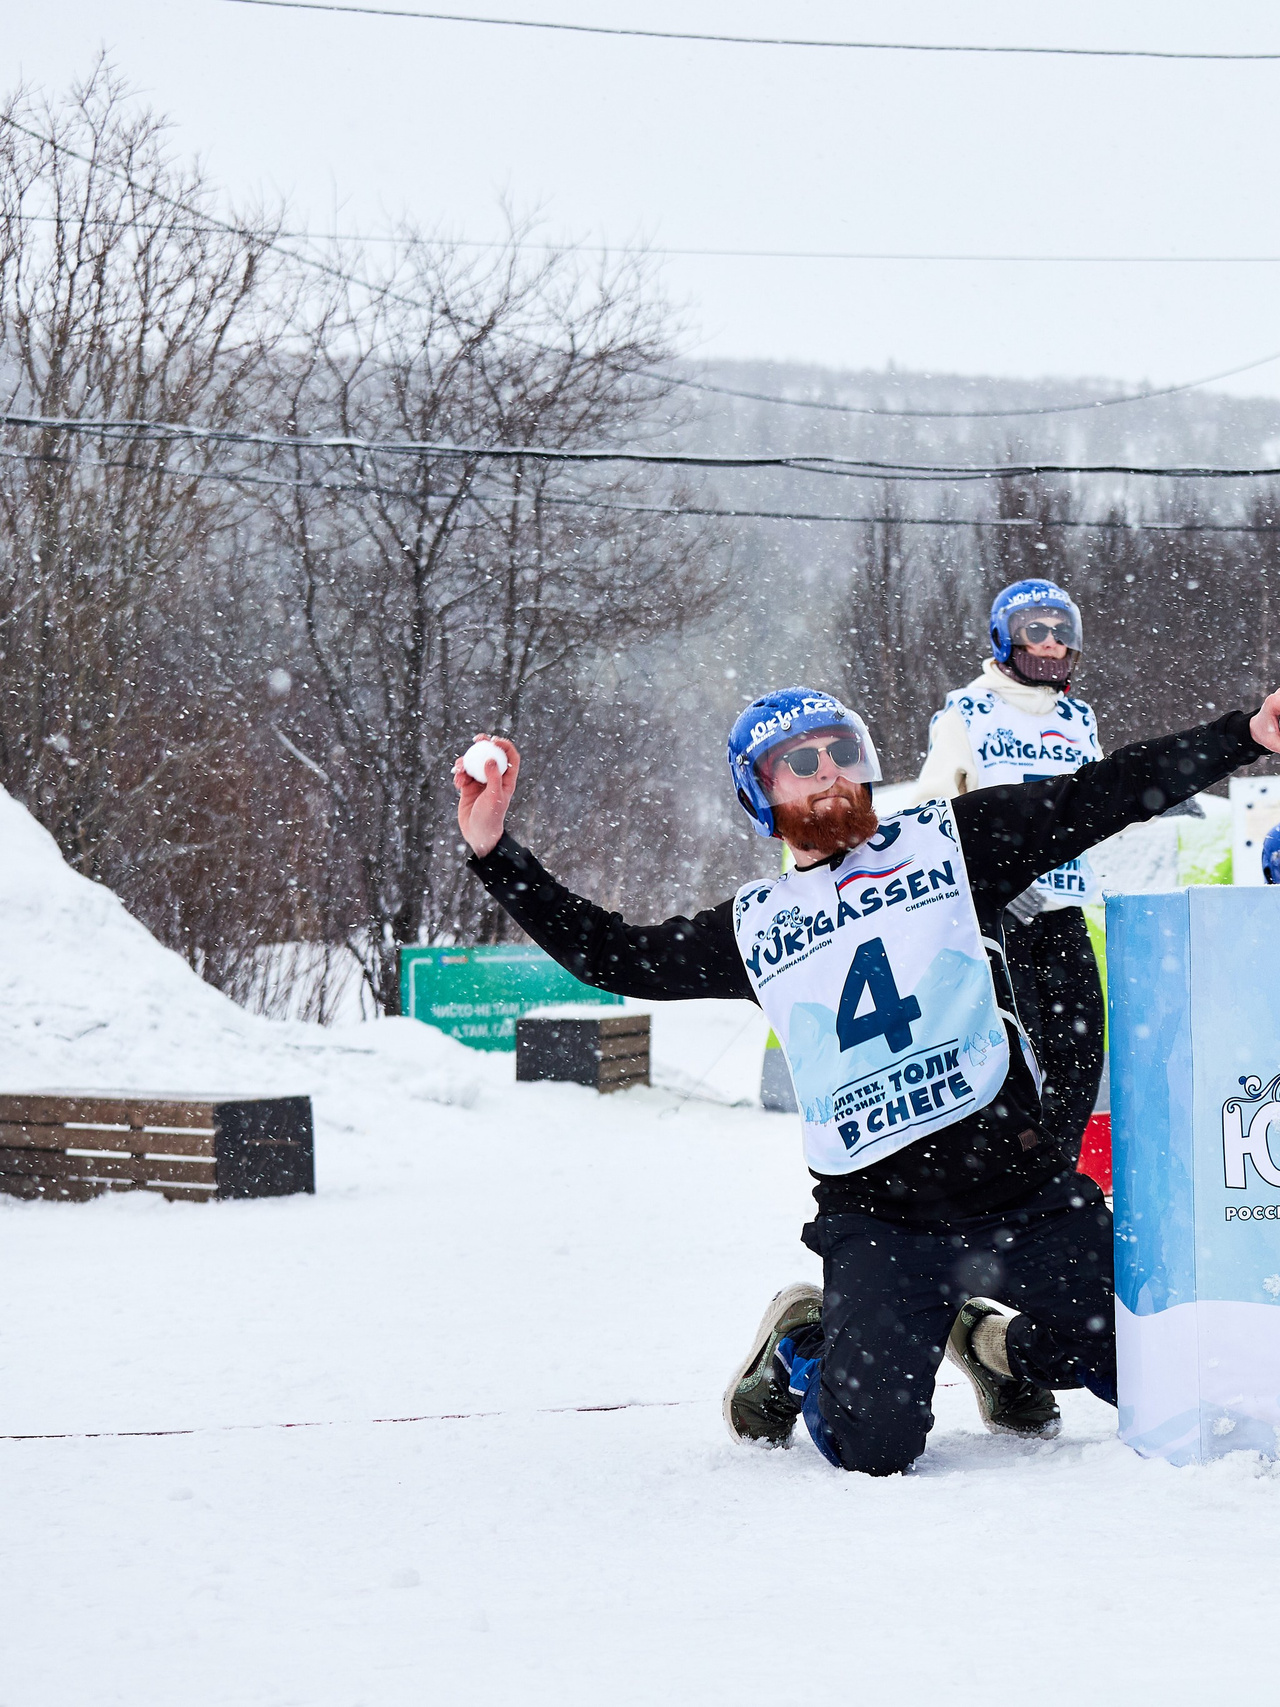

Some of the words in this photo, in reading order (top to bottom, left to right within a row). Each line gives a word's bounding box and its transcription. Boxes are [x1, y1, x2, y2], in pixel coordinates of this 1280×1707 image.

[905, 893, 944, 912] СНЕЖНЫЙ
[945, 889, 960, 899] БОЙ
[836, 937, 921, 1053] 4
[888, 1047, 960, 1093] ТОЛК
[834, 1092, 855, 1113] ДЛЯ
[854, 1080, 884, 1098] ТЕХ,
[834, 1107, 854, 1122] КТО
[855, 1091, 886, 1112] ЗНАЕТ
[837, 1120, 861, 1150] В
[866, 1071, 974, 1133] СНЕГЕ
